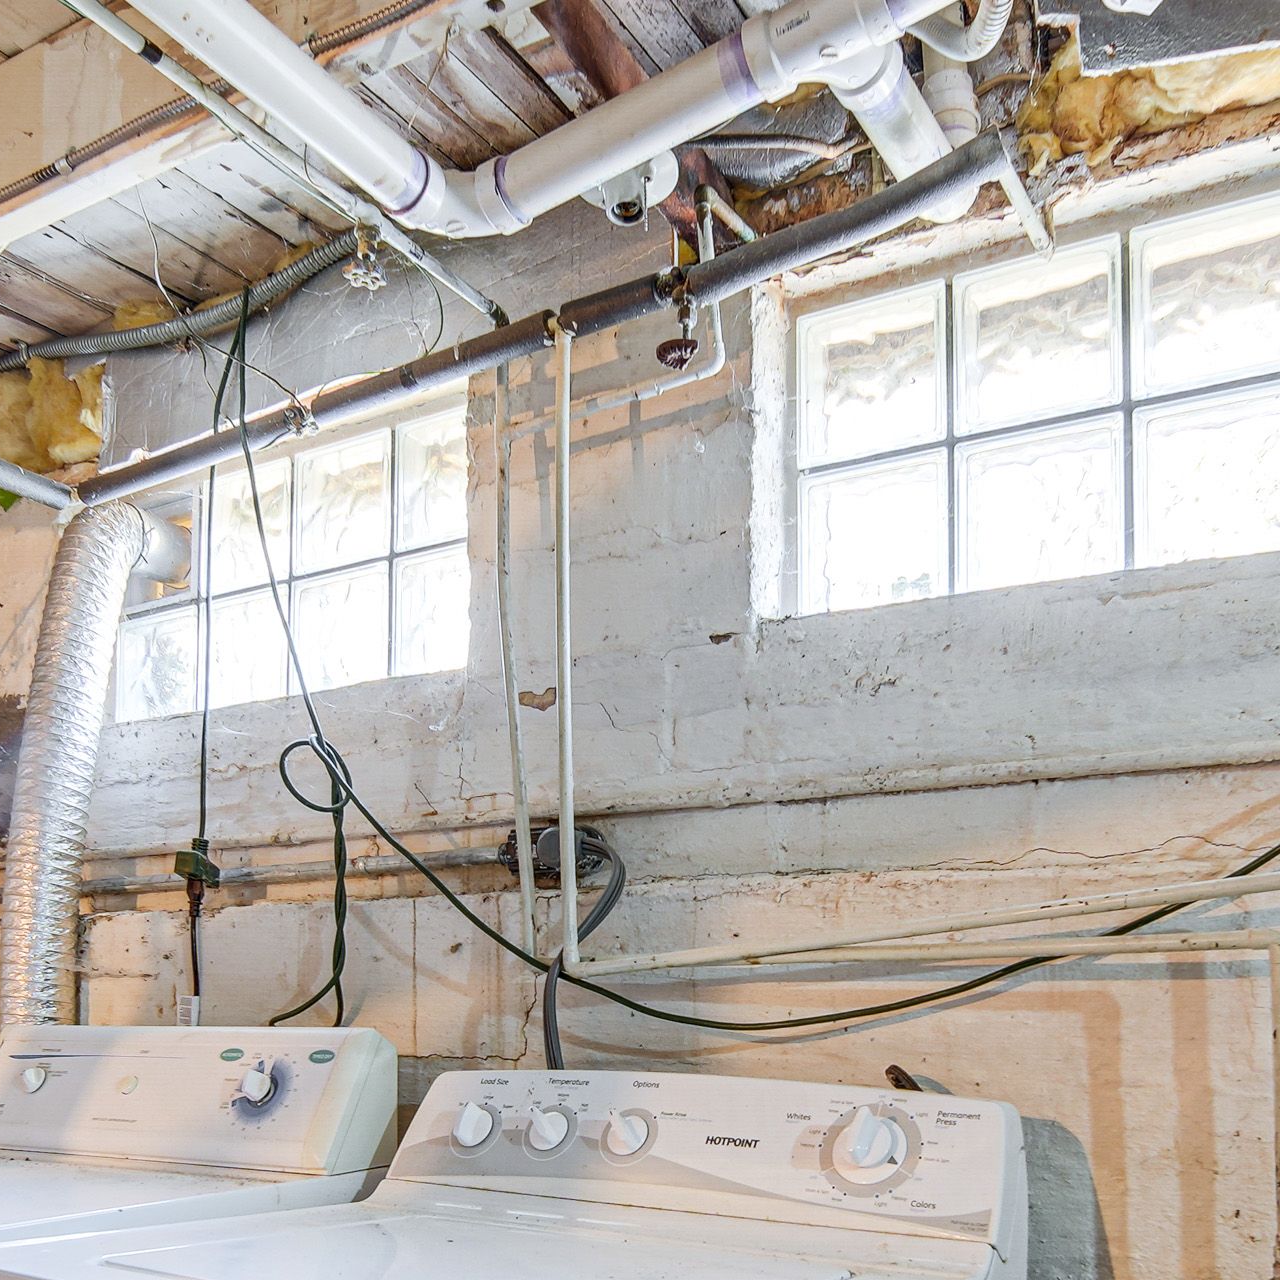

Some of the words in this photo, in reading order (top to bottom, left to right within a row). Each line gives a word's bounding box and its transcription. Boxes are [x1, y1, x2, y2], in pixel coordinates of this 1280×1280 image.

[496, 1078, 509, 1086] Size
[548, 1078, 590, 1086] Temperature
[633, 1080, 660, 1089] Options
[786, 1112, 811, 1121] Whites
[937, 1110, 981, 1120] Permanent
[936, 1118, 957, 1126] Press
[705, 1136, 760, 1148] HOTPOINT
[910, 1200, 936, 1209] Colors
